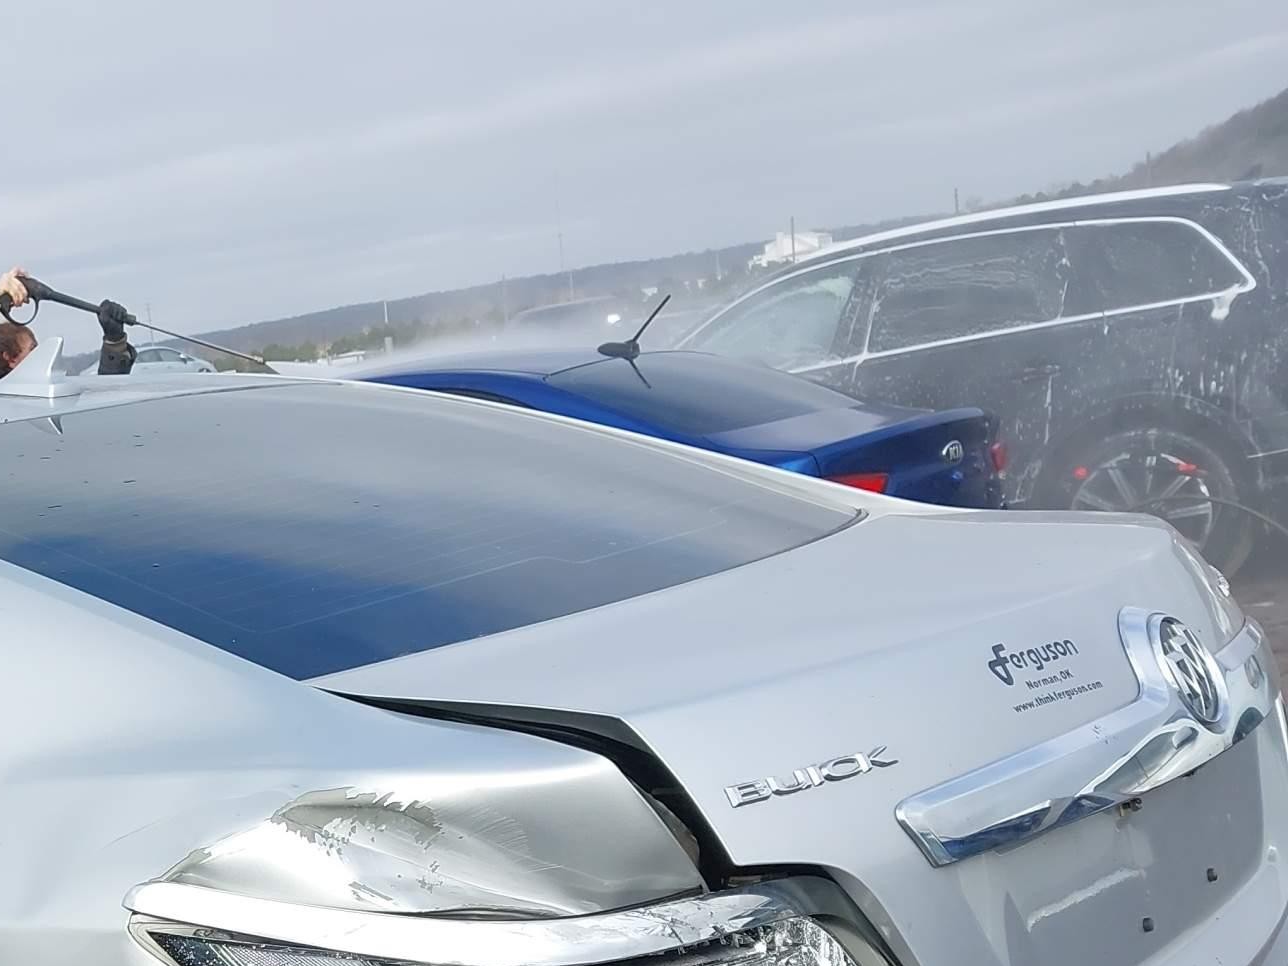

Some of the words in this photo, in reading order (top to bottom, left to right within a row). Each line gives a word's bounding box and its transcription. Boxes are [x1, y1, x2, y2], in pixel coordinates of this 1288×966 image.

[988, 639, 1079, 686] Ferguson
[1013, 680, 1103, 713] www.thinkferguson.com
[724, 746, 899, 808] BUICK
